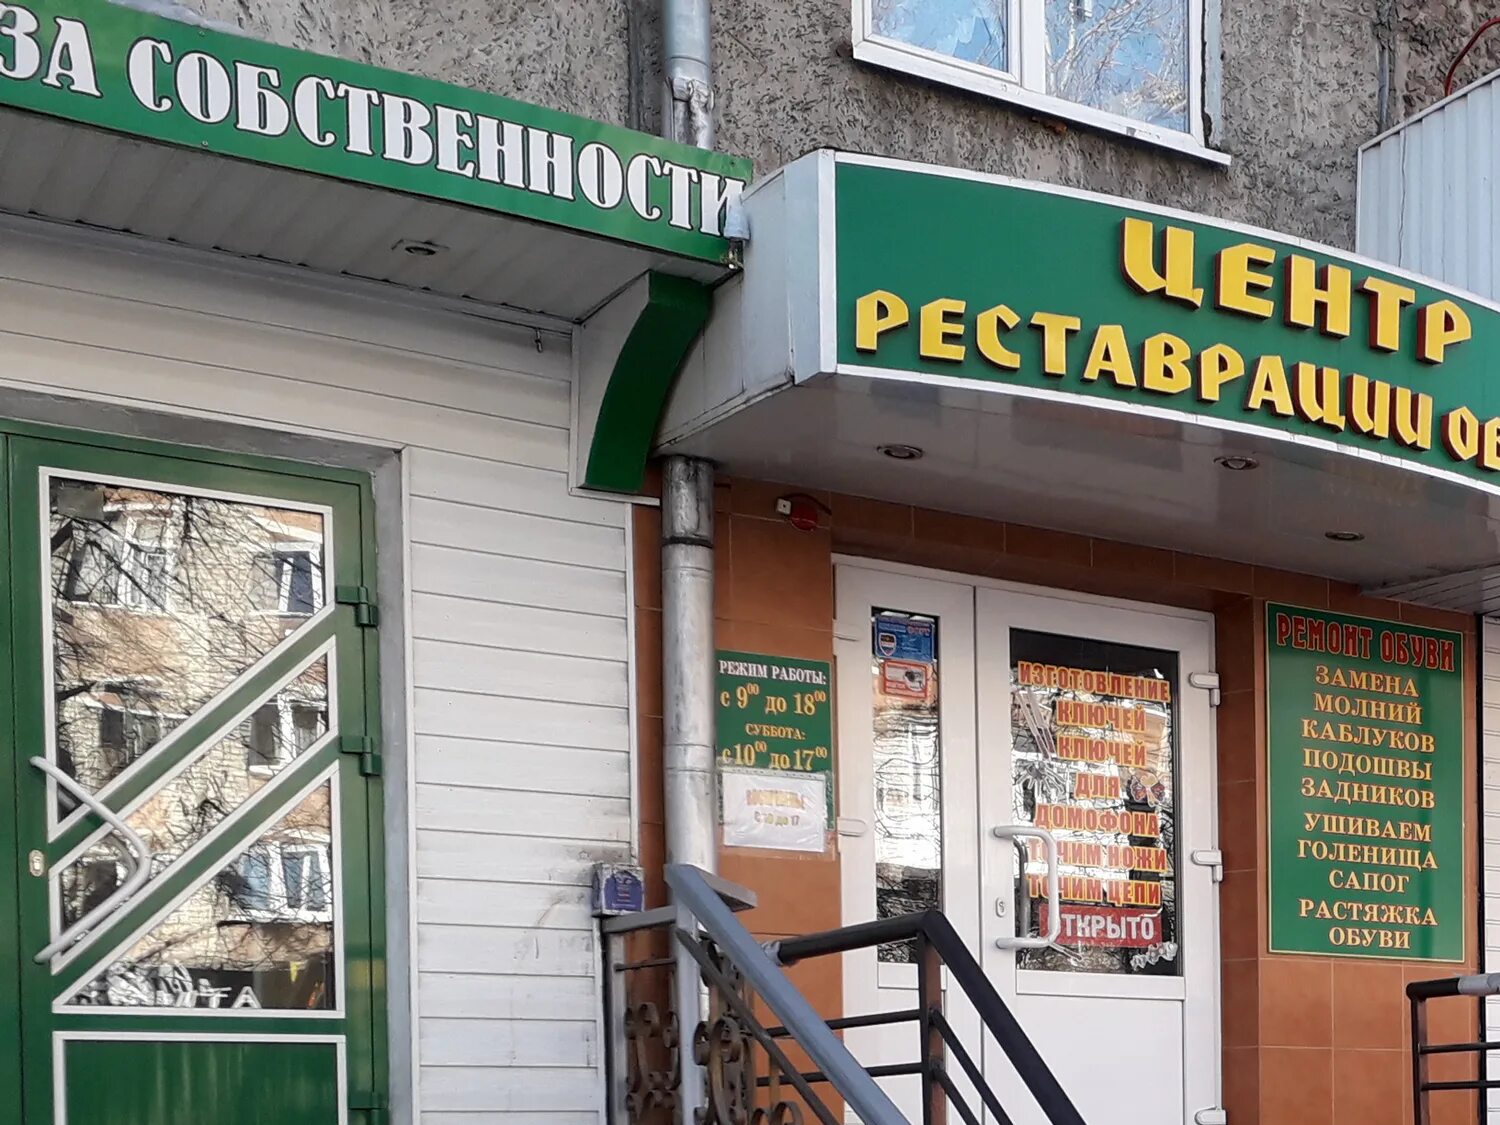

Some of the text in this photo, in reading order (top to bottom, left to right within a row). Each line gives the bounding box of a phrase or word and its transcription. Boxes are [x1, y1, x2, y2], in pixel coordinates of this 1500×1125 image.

[127, 36, 746, 237] СОБСТВЕННОСТИ
[1120, 216, 1471, 365] ЦЕНТР
[854, 289, 1433, 452] РЕСТАВРАЦИИ
[1276, 613, 1455, 672] РЕМОНТ ОБУВИ
[719, 660, 827, 685] РЕЖИМ РАБОТЫ:
[1018, 661, 1171, 703] ИЗГОТОВЛЕНИЕ
[1315, 665, 1419, 698] ЗАМЕНА
[765, 696, 787, 715] до
[1057, 700, 1146, 733] КЛЮЧЕЙ
[1313, 692, 1422, 725] МОЛНИЙ
[745, 723, 805, 741] СУББОТА:
[1302, 719, 1435, 753] КАБЛУКОВ
[769, 752, 791, 770] до
[1057, 733, 1146, 768] КЛЮЧЕЙ
[1303, 748, 1432, 781] ПОДОШВЫ
[1074, 771, 1121, 800] ДЛЯ
[1302, 777, 1435, 809] ЗАДНИКОВ
[1033, 803, 1161, 838] ДОМОФОНА
[1304, 812, 1431, 842] УШИВАЕМ
[1107, 845, 1168, 873] НОЖИ
[1298, 839, 1438, 871] ГОЛЕНИЩА
[1107, 880, 1162, 907] ЦЕПИ
[1329, 869, 1409, 893] САПОГ
[1060, 914, 1155, 940] ТКРЫТО
[1299, 898, 1438, 926] РАСТЯЖКА
[1329, 926, 1411, 950] ОБУВИ
